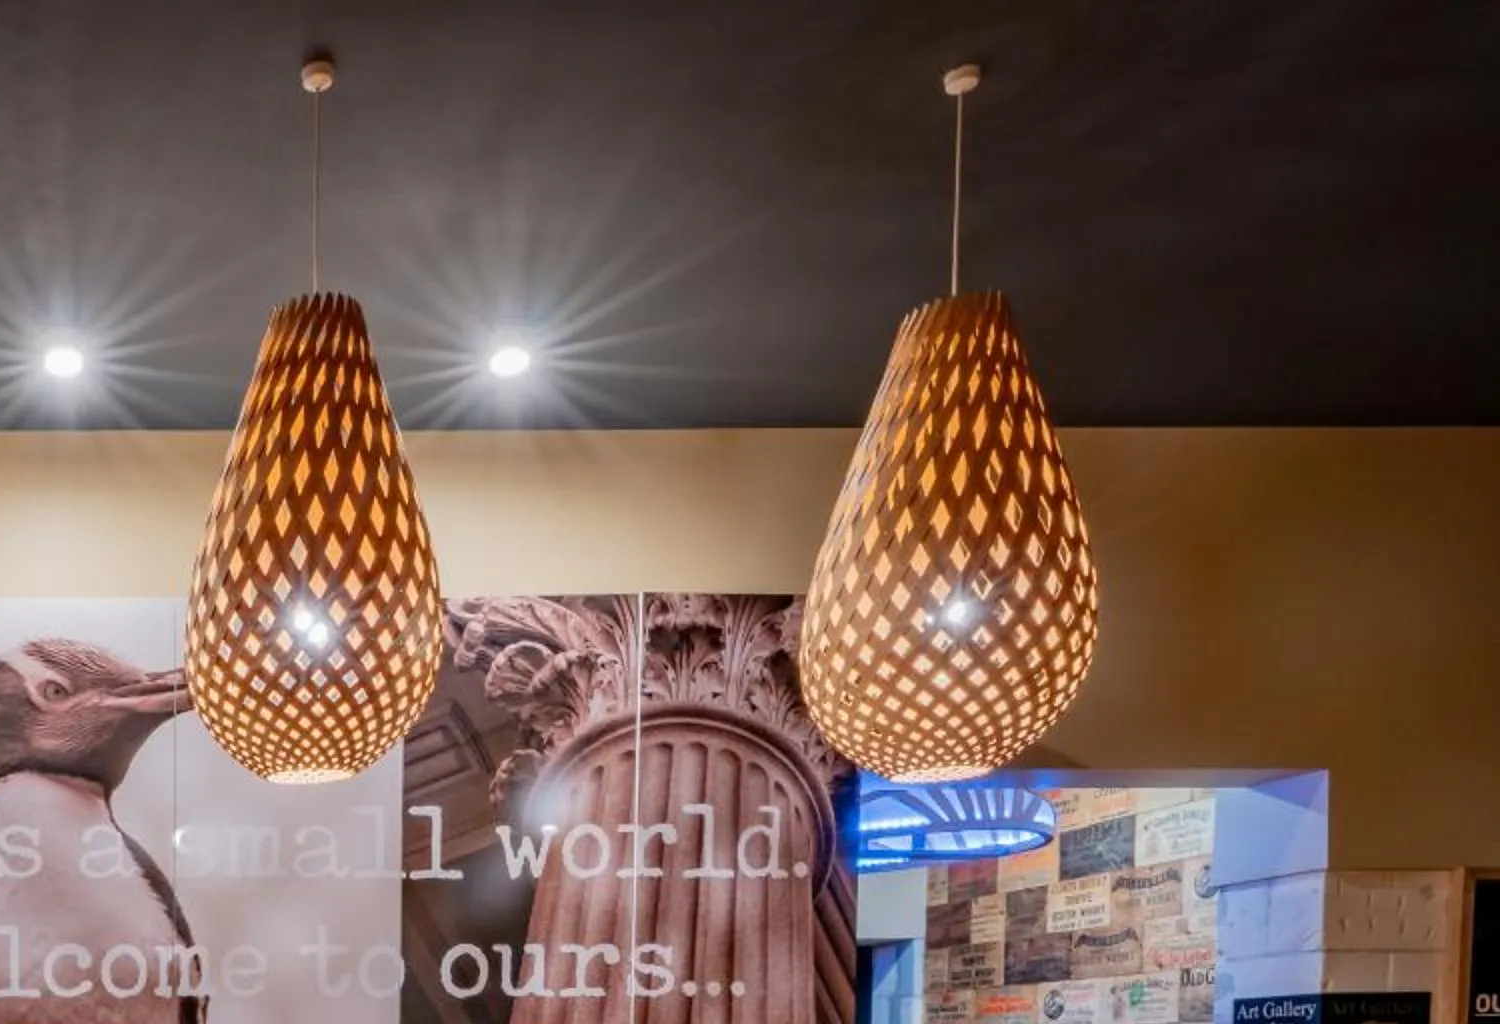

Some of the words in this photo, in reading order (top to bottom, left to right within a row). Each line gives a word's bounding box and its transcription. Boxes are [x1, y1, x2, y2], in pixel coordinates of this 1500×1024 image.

[77, 822, 140, 879] a
[173, 804, 464, 880] small
[495, 803, 810, 880] world.
[299, 924, 405, 999] to
[439, 942, 746, 1000] ours...
[1236, 1003, 1260, 1020] Art
[1262, 1000, 1317, 1020] Gallery
